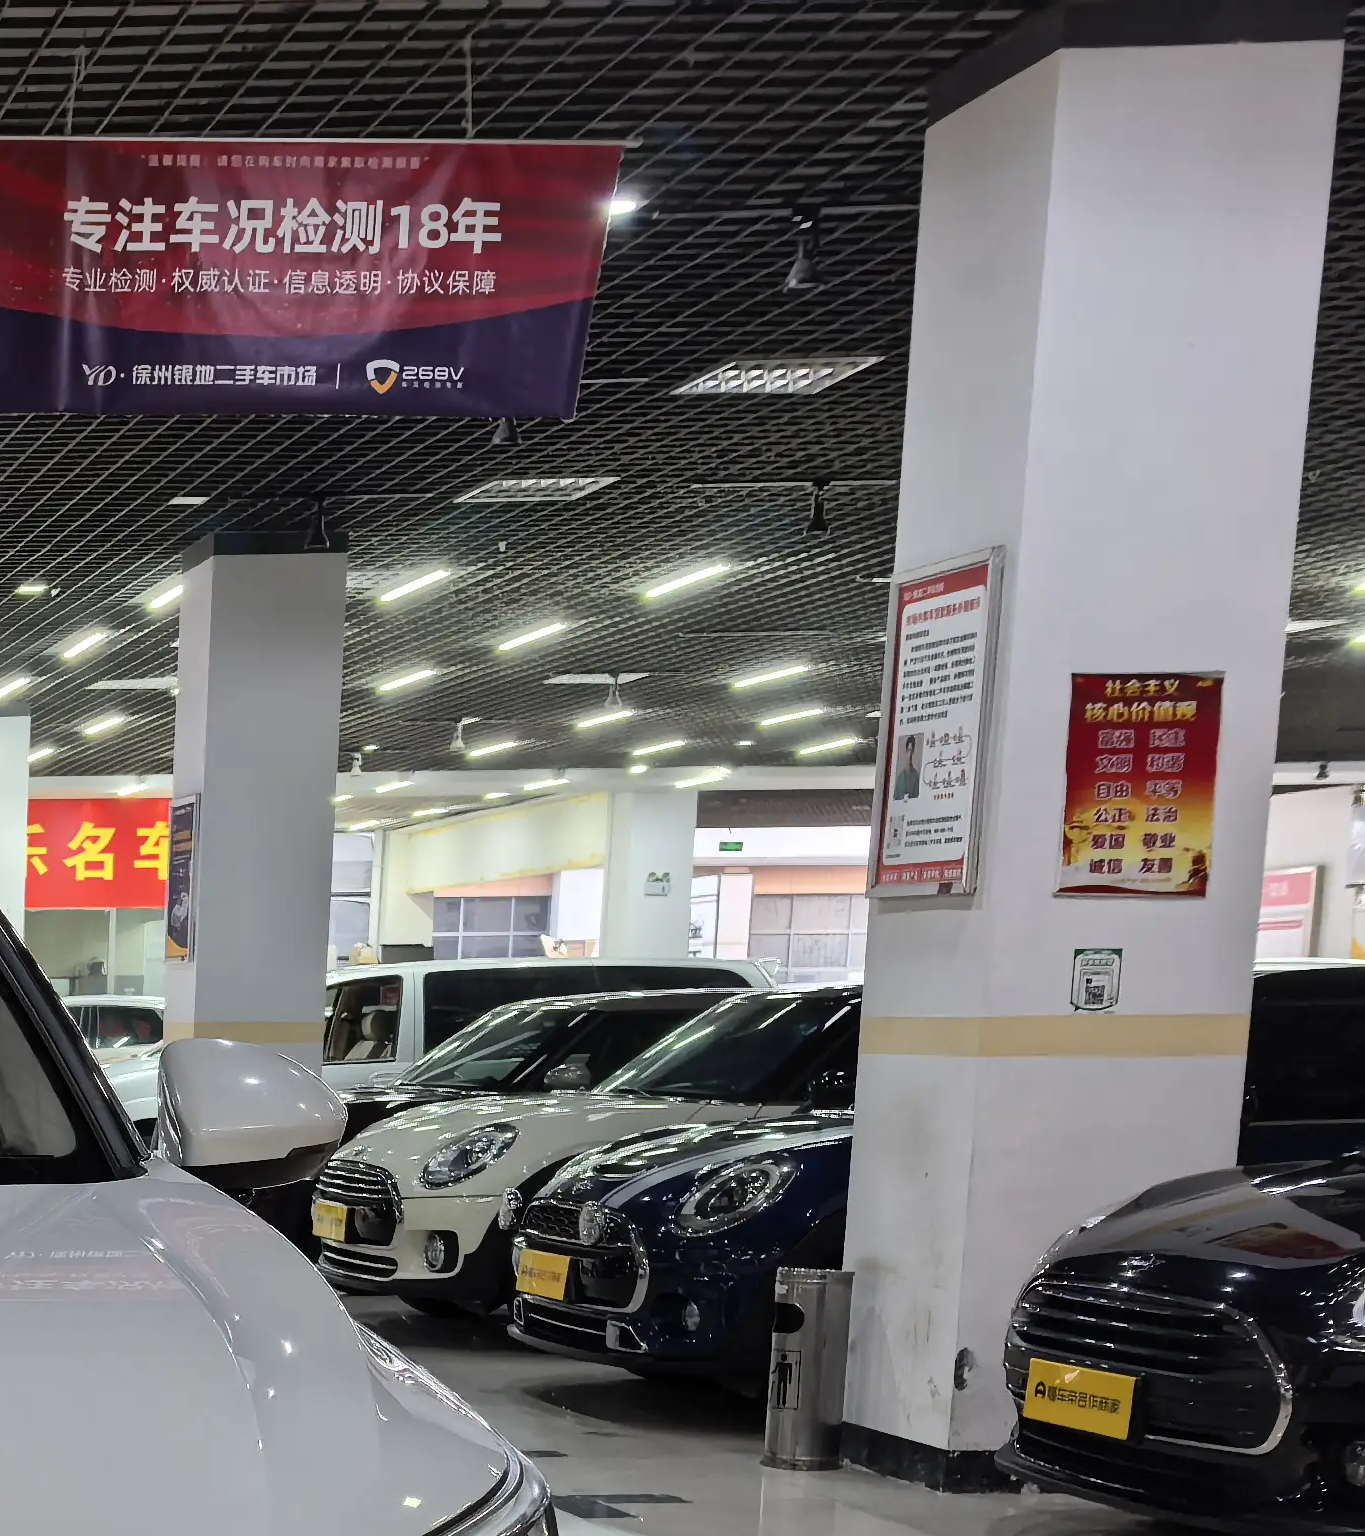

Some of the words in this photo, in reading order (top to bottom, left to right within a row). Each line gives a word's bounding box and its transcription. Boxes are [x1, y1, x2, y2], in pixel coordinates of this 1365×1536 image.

[64, 196, 503, 255] 专注车况检测18年
[402, 365, 466, 380] 268V
[1105, 678, 1180, 698] 社会主义
[1084, 700, 1198, 723] 核心价值观
